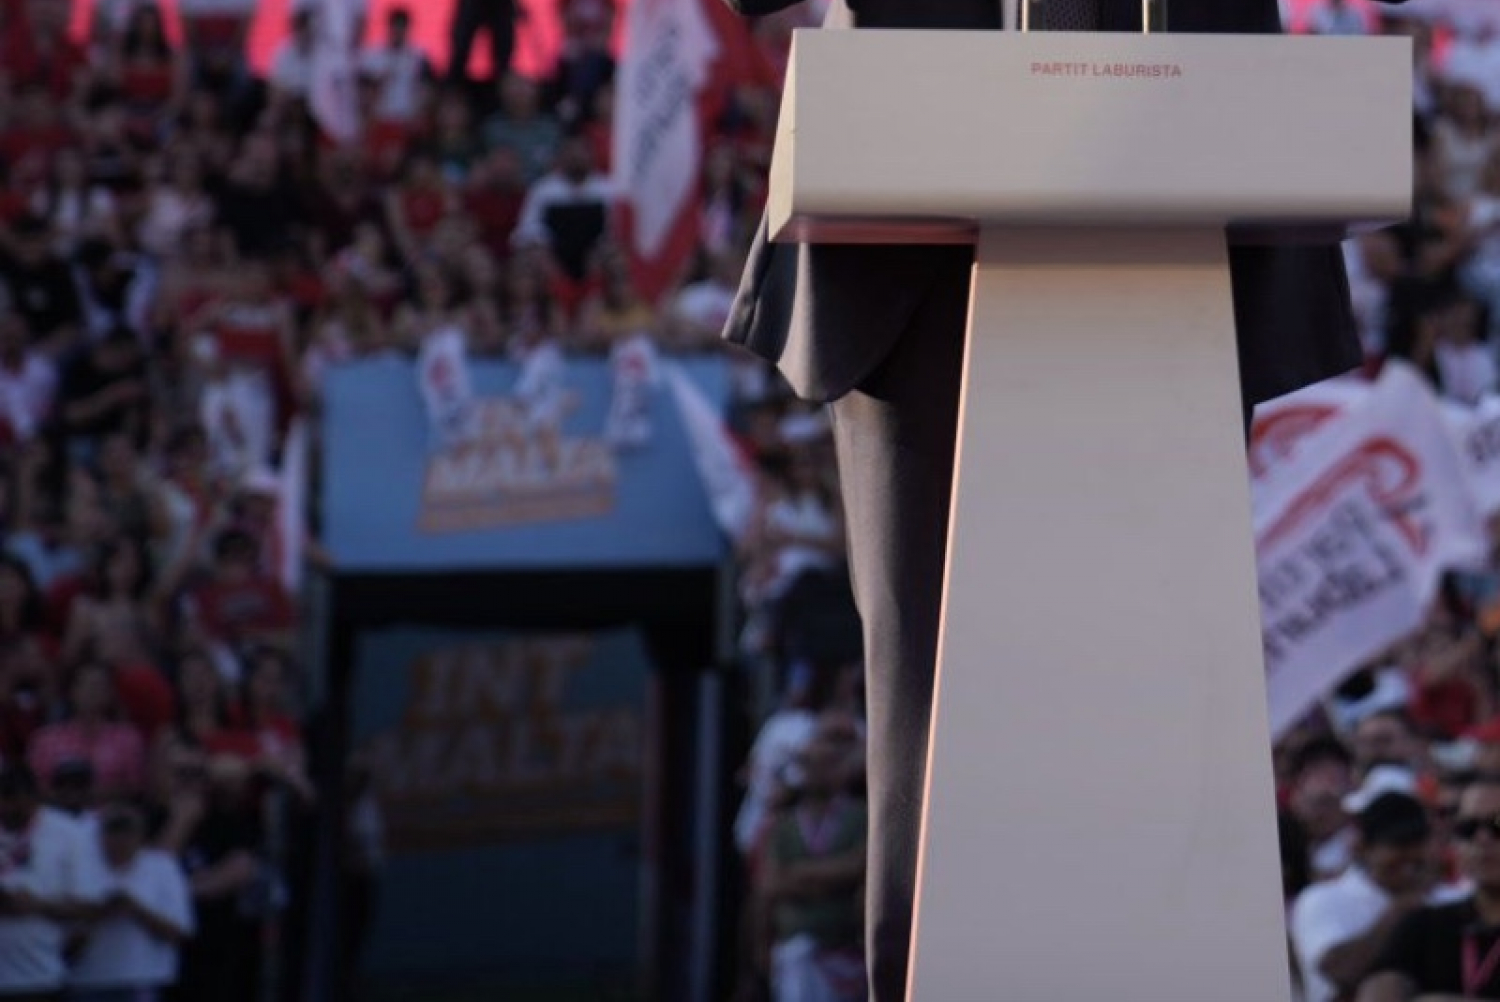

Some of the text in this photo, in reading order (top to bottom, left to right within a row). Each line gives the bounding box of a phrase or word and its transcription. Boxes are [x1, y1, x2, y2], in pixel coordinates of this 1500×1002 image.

[1031, 62, 1182, 77] PARTIT LABURISTA
[408, 635, 594, 725] INT
